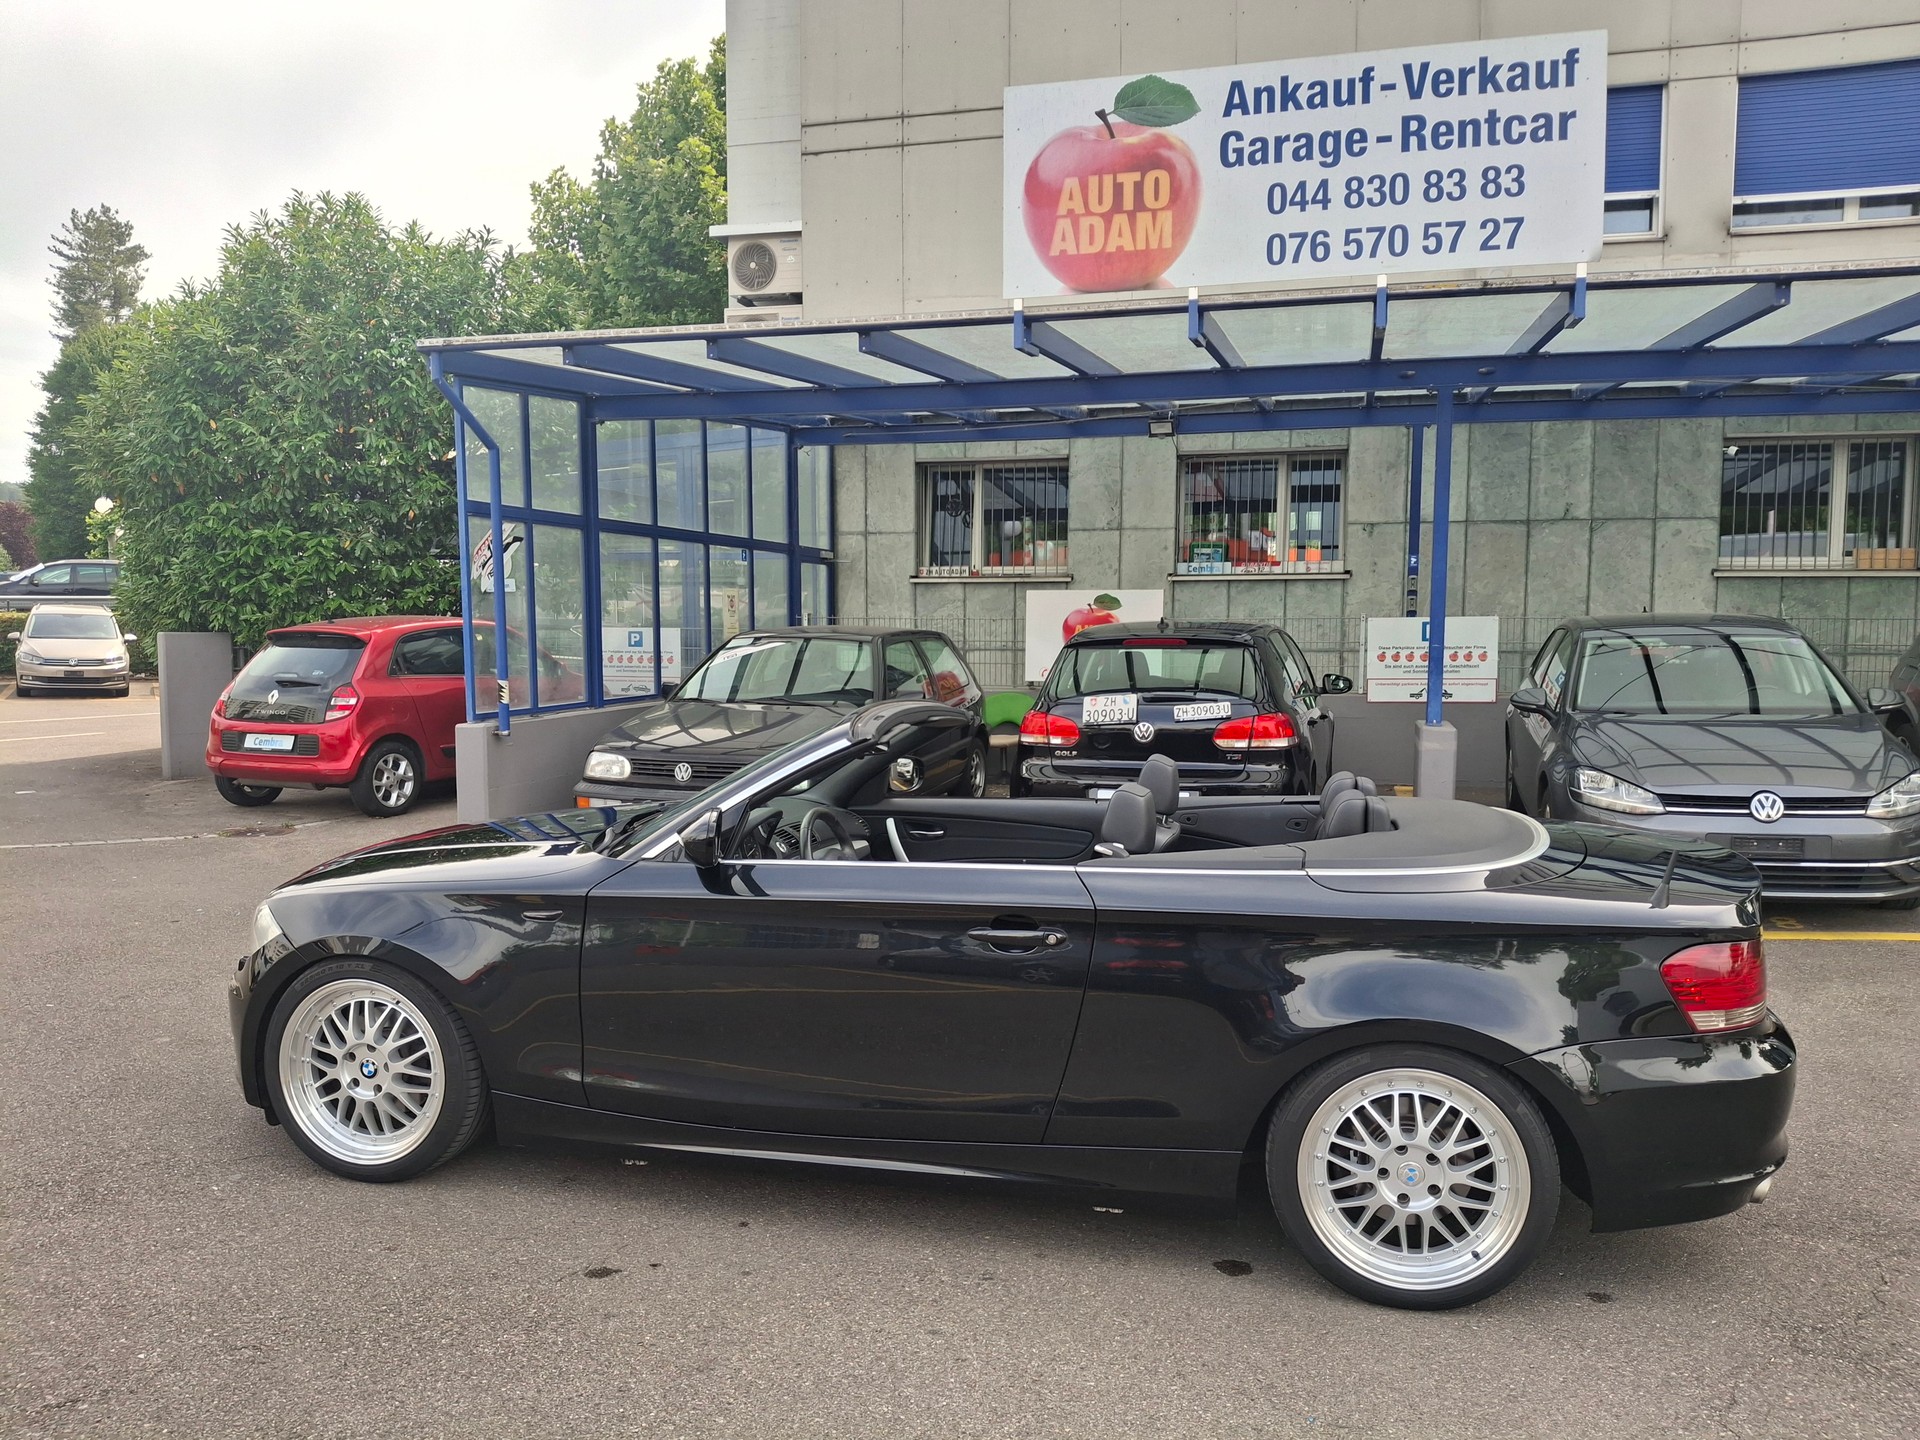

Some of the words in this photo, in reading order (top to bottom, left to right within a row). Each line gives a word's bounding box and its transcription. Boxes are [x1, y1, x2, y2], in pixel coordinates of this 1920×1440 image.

[1056, 168, 1171, 215] AUTO
[1267, 178, 1331, 215] 044
[1343, 172, 1410, 209] 830
[1422, 168, 1467, 203] 83
[1480, 163, 1526, 199] 83
[1049, 209, 1173, 256] ADAM
[1266, 229, 1331, 266] 076
[1343, 224, 1409, 261] 570
[1422, 220, 1467, 255] 57
[1479, 216, 1525, 251] 27
[1187, 564, 1221, 573] Cembra
[630, 633, 640, 645] P
[1104, 697, 1117, 707] ZH
[253, 737, 283, 747] Cembra
